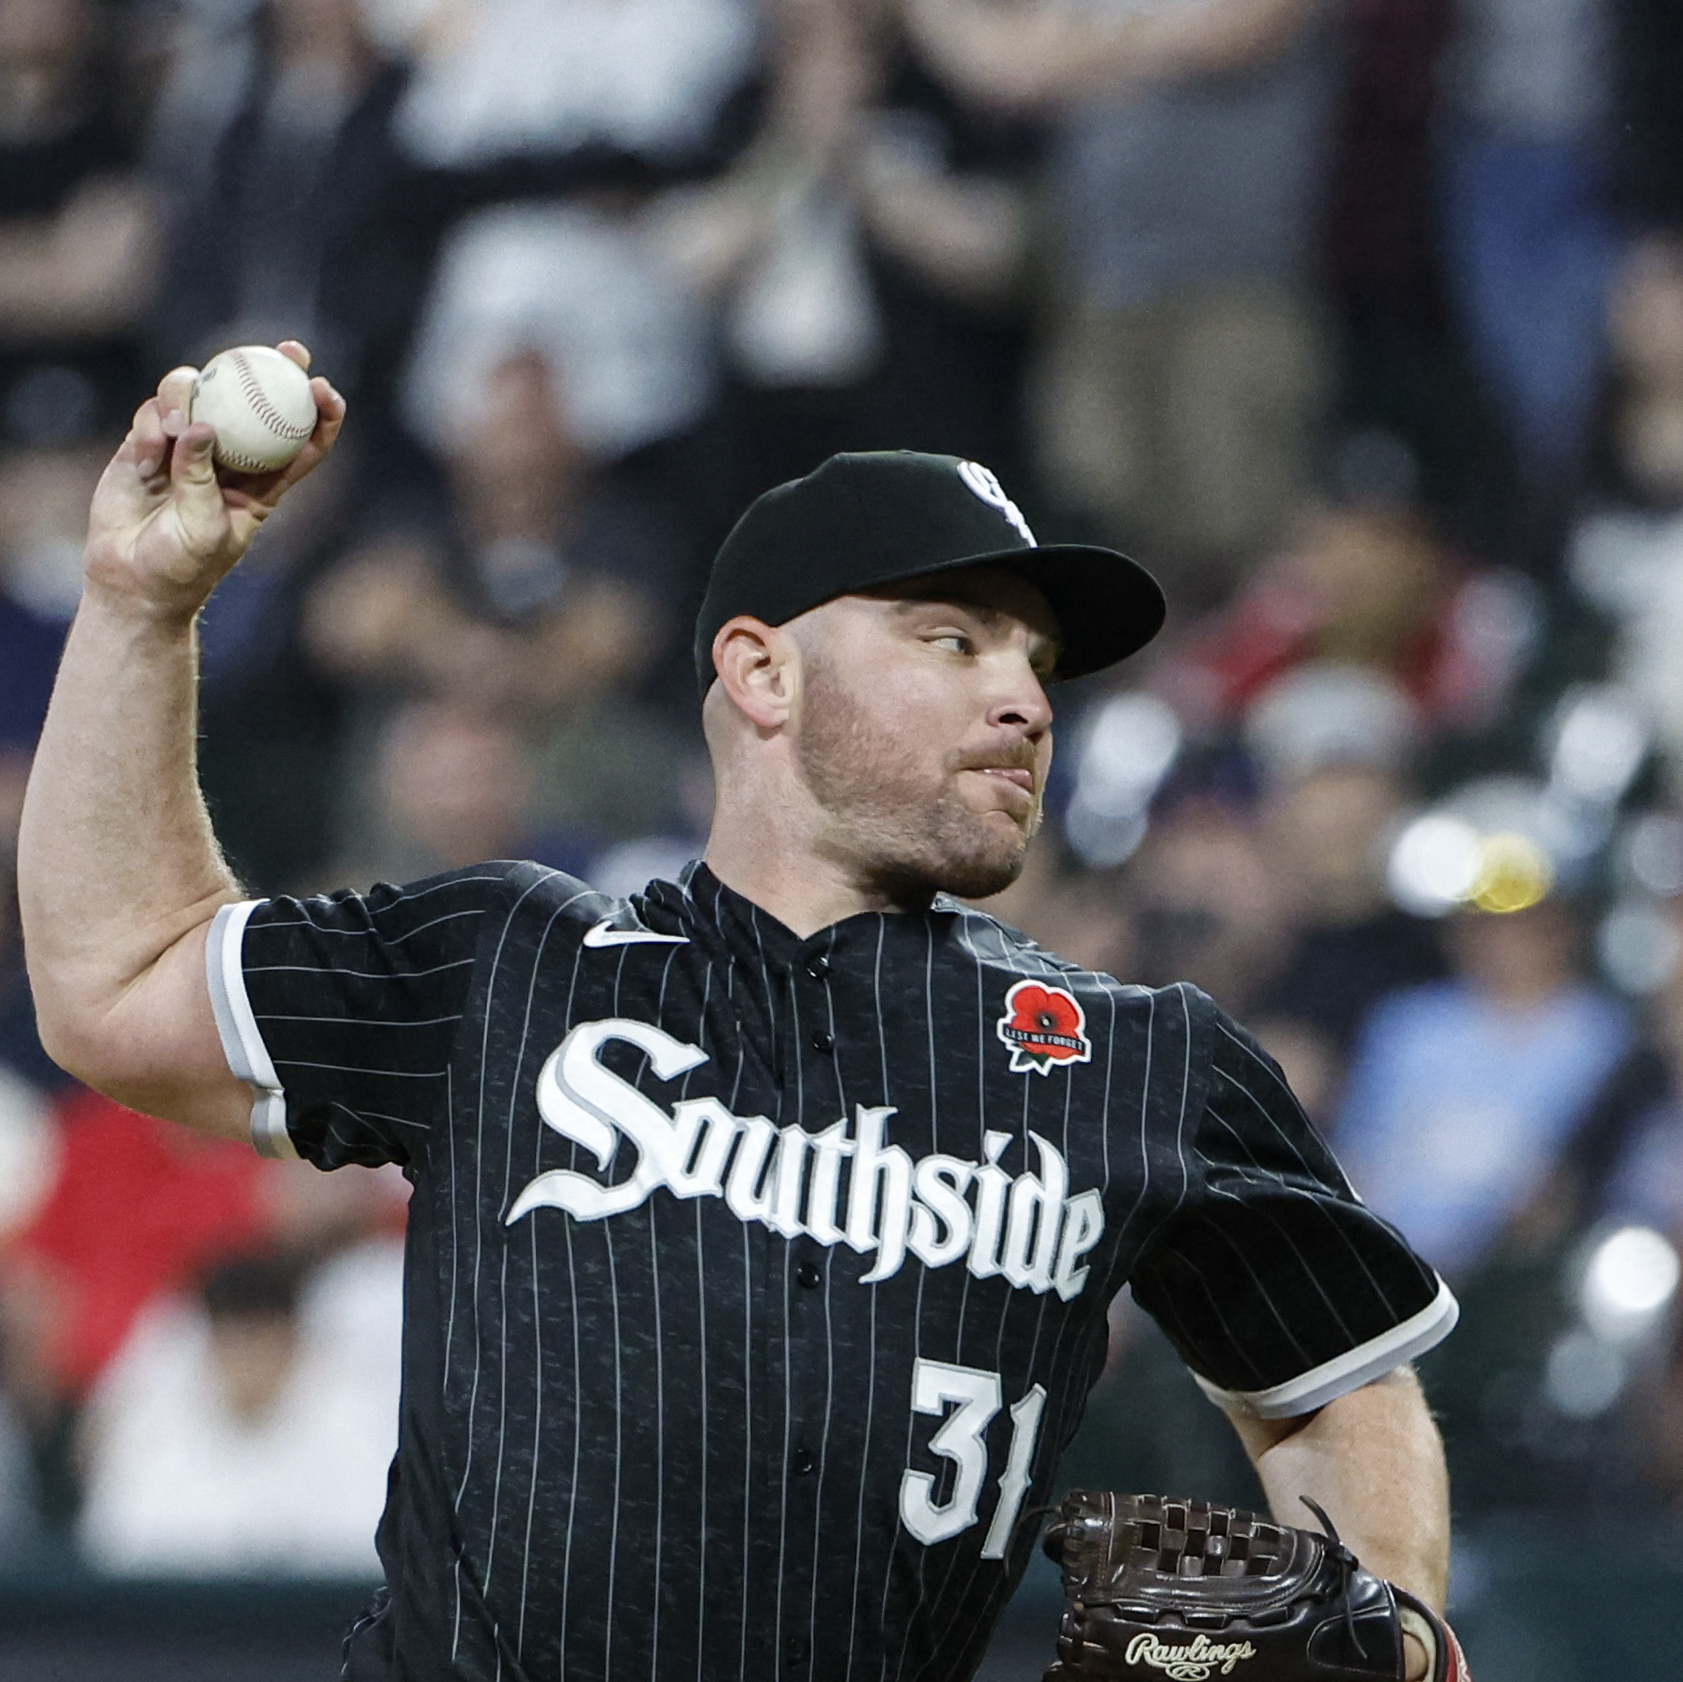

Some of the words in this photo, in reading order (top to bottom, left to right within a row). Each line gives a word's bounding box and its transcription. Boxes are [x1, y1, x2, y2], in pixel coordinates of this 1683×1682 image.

[1005, 1027, 1028, 1042] LEST
[1030, 1034, 1046, 1044] WE
[1047, 1035, 1083, 1051] FORGET
[505, 1018, 1104, 1301] Southside
[899, 1357, 1047, 1560] 31
[1125, 1632, 1257, 1675] Rawlings
